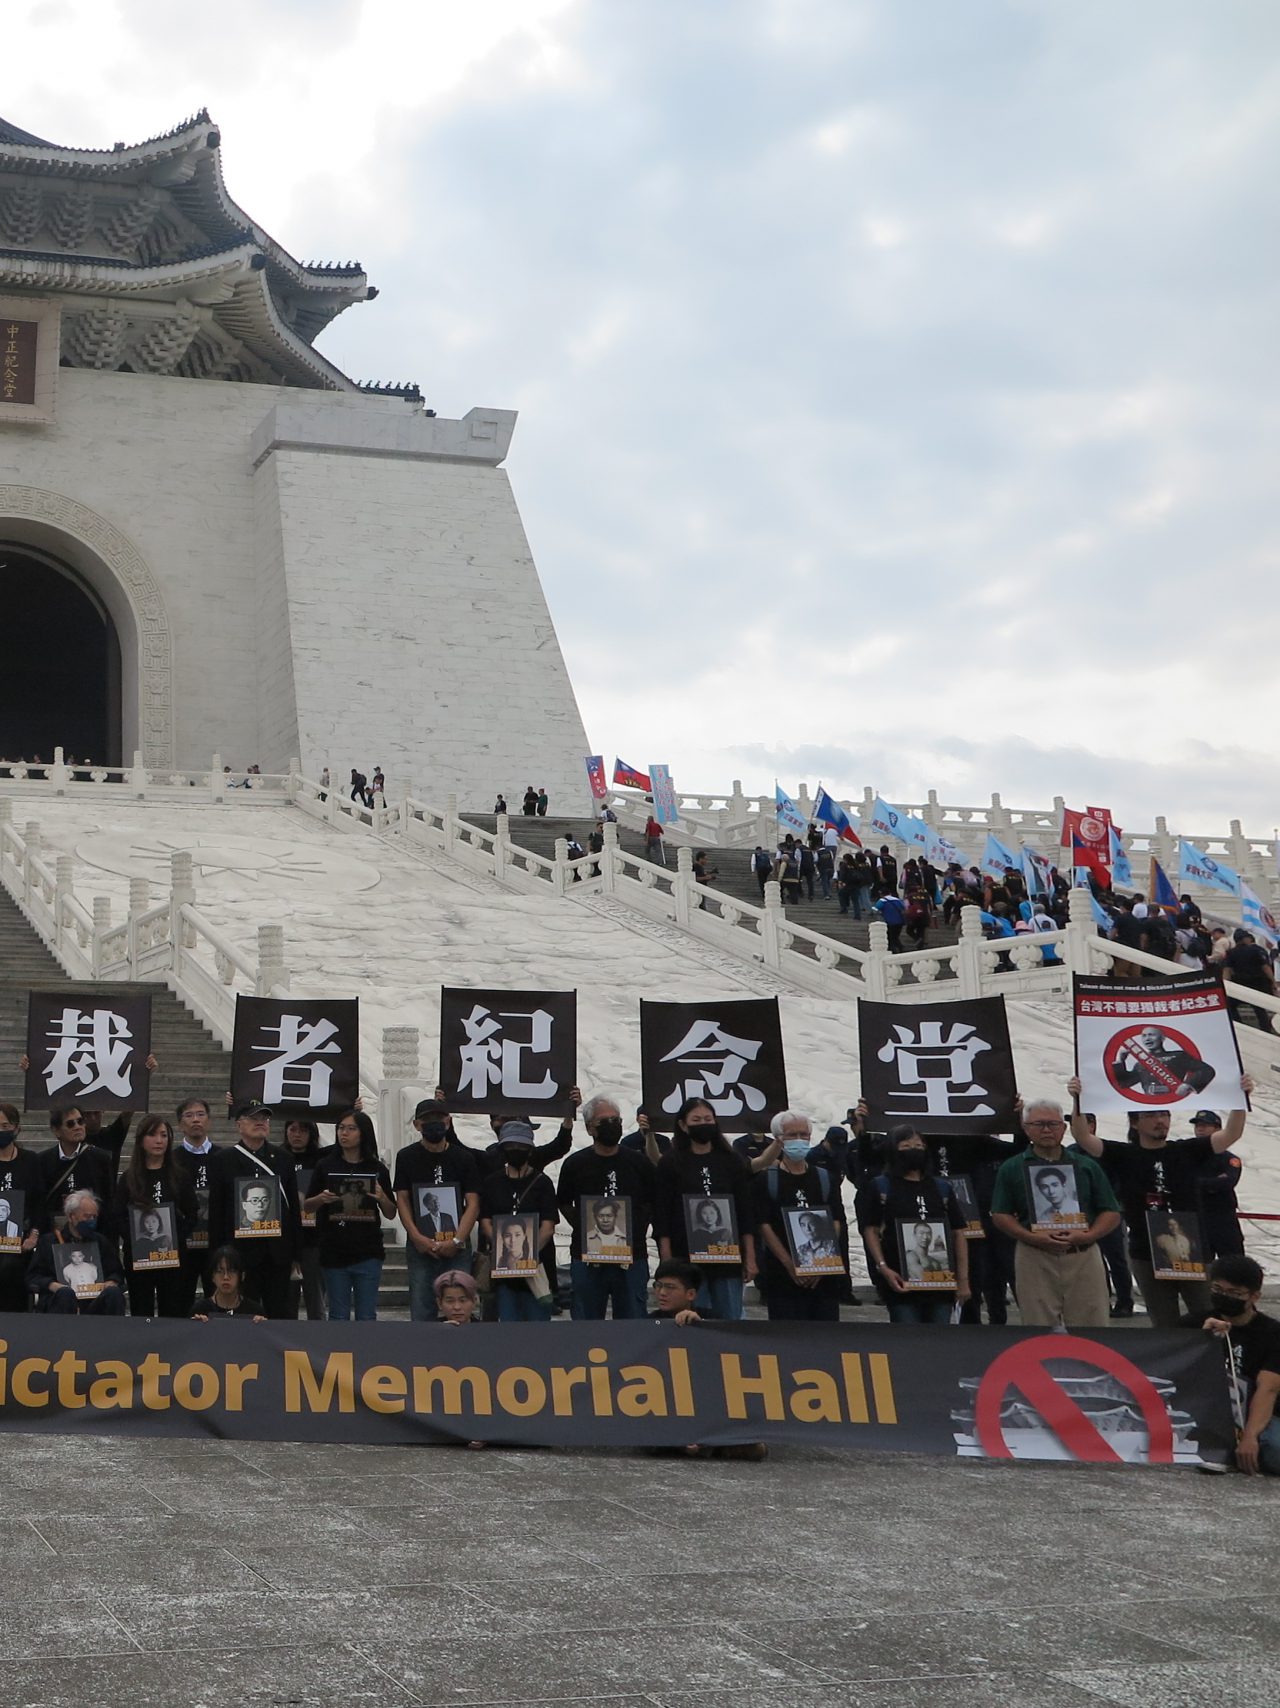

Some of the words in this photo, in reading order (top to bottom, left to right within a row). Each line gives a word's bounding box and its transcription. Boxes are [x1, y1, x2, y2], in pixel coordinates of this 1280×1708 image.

[4, 324, 19, 398] 中正紀念堂
[41, 1007, 134, 1098] 裁
[249, 1014, 342, 1107] 者
[456, 1004, 559, 1099] 紀
[659, 1019, 767, 1117] 念
[877, 1021, 996, 1117] 堂
[1145, 1057, 1178, 1086] Dictator
[284, 1347, 695, 1416] Memorial
[720, 1352, 897, 1424] Hall
